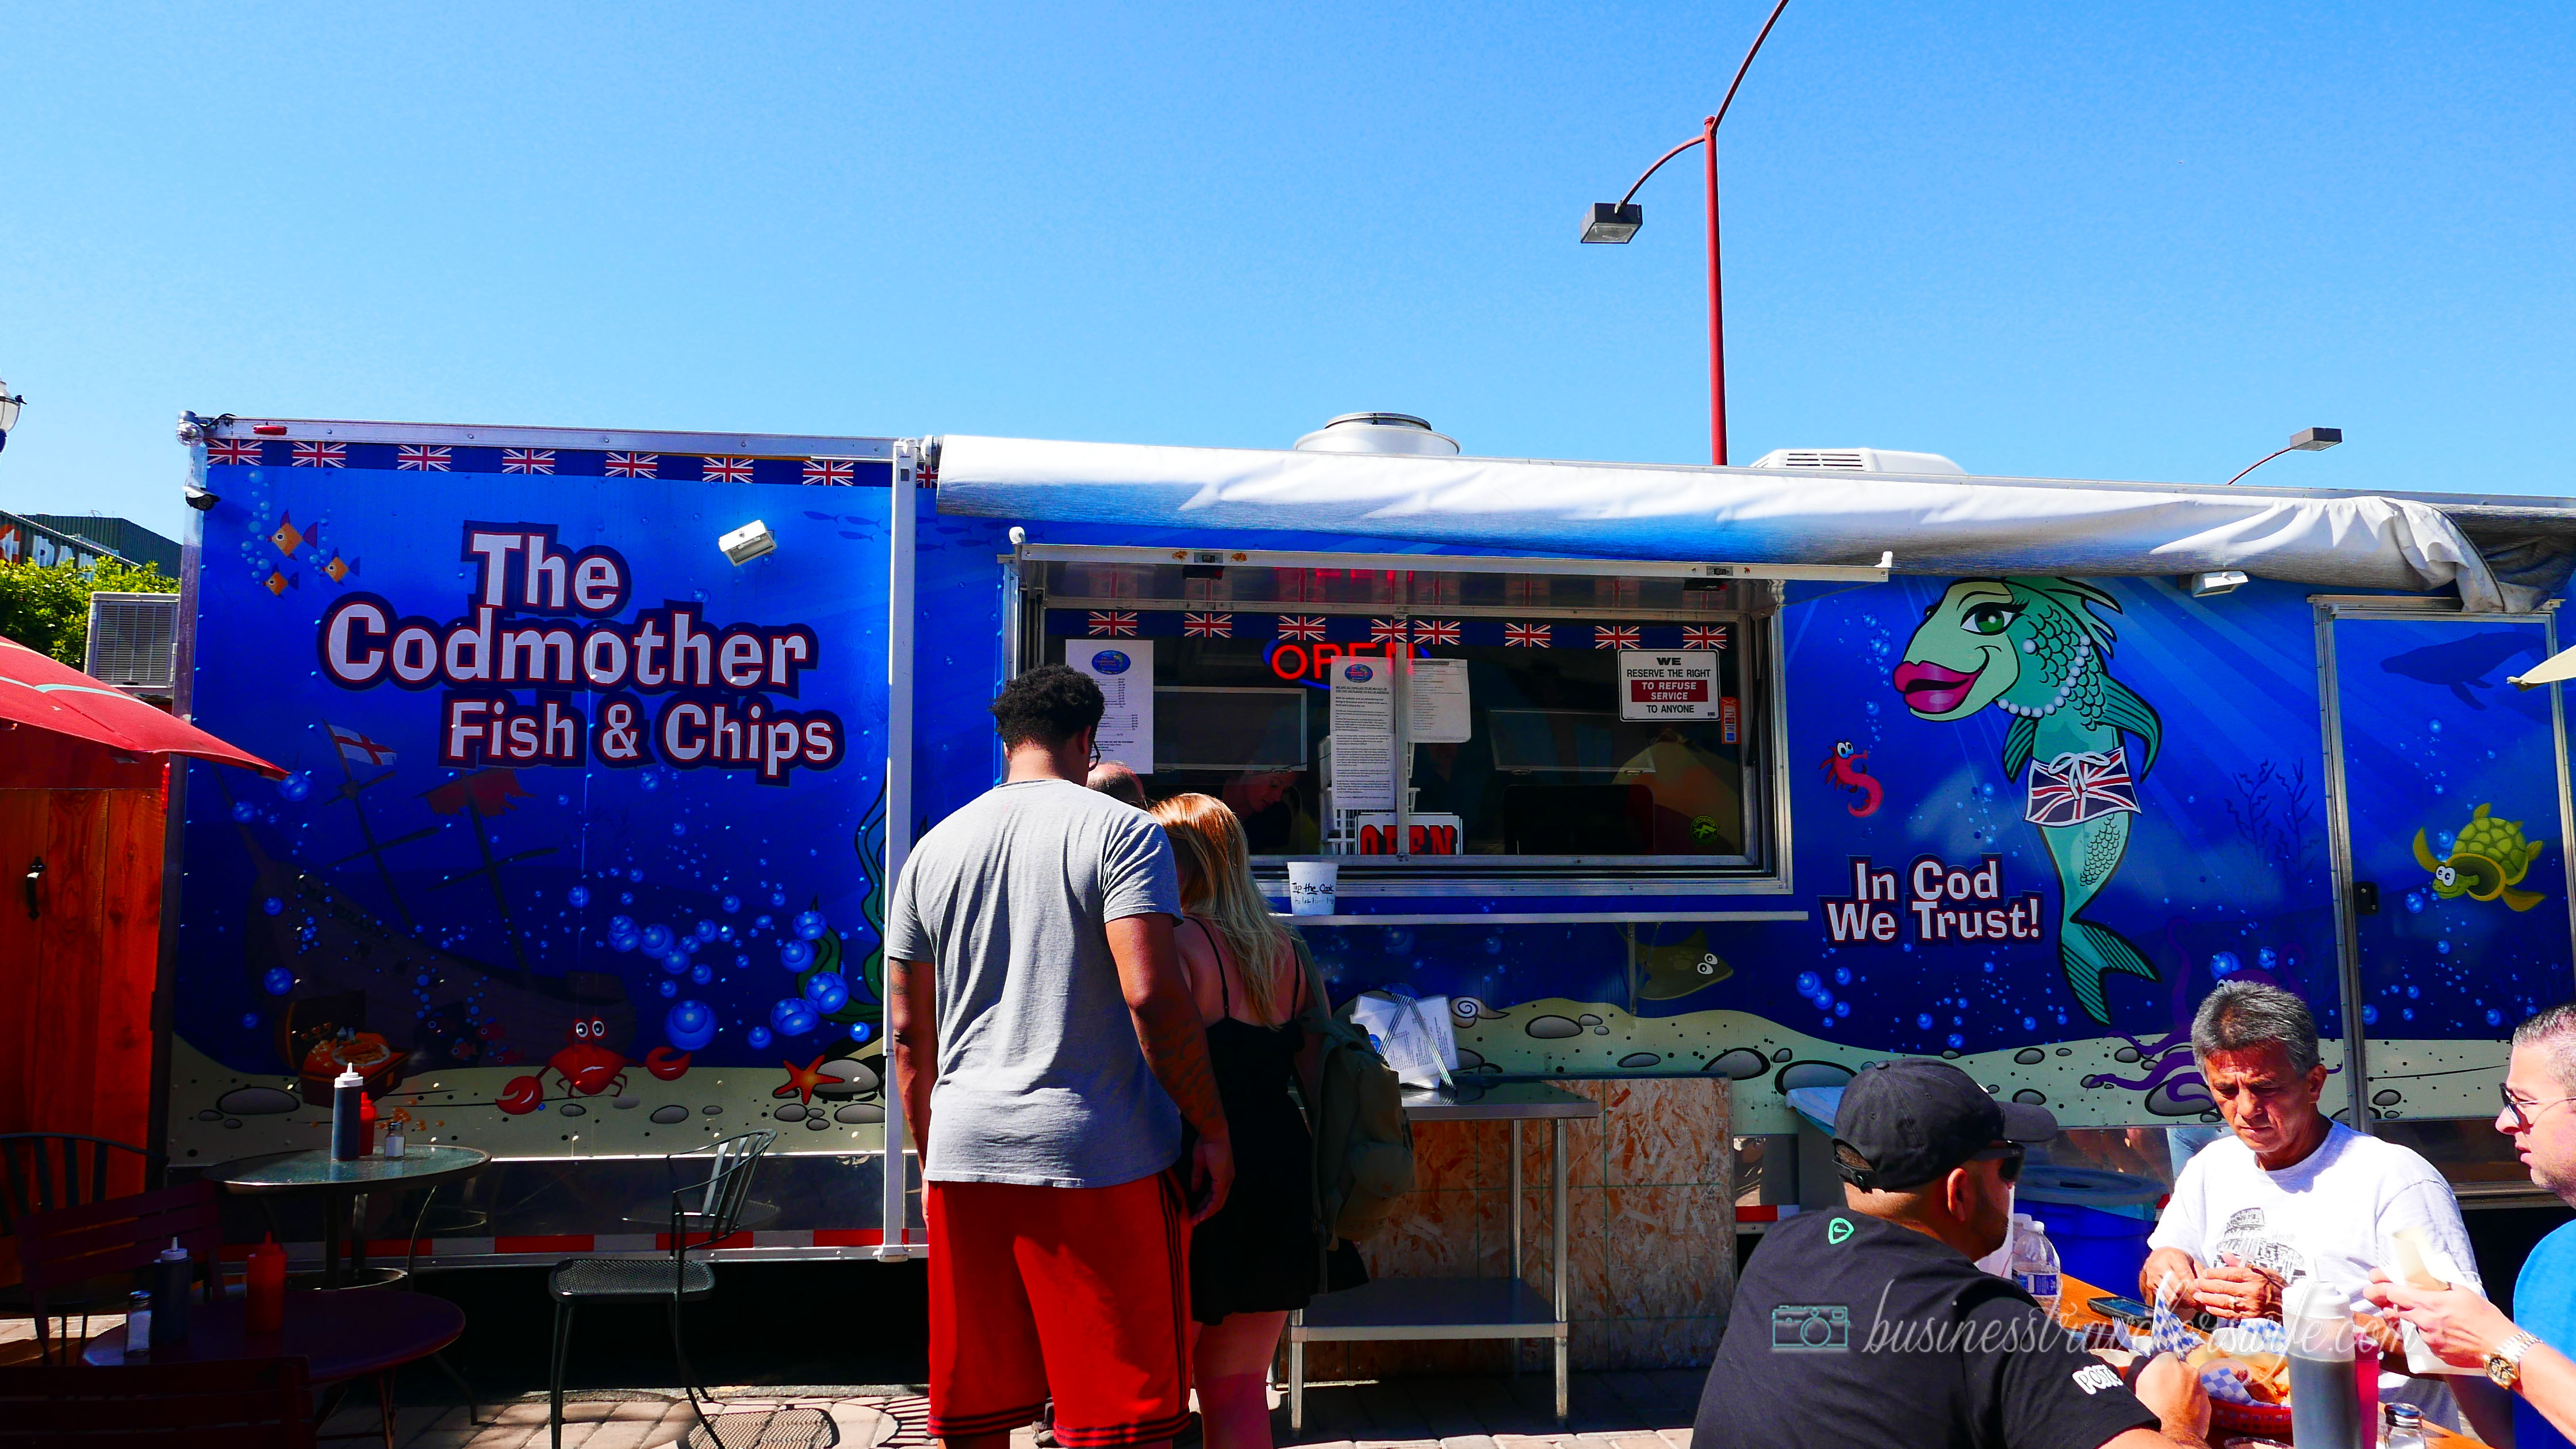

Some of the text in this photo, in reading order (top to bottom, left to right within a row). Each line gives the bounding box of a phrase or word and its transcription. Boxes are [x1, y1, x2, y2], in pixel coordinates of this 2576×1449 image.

[471, 532, 620, 611] The
[327, 603, 808, 688] Codmother
[1656, 657, 1681, 666] WE
[1627, 669, 1711, 677] RESERVE THE RIGHT
[1642, 681, 1697, 690] TO REFUSE
[1651, 692, 1688, 700] SERVICE
[1646, 705, 1695, 713] TO ANYONE
[448, 700, 834, 777] Fish & Chips
[1856, 860, 2000, 901] In Cod
[1291, 882, 1302, 894] Tip
[1304, 882, 1318, 892] the
[1827, 899, 2040, 941] We Trust!
